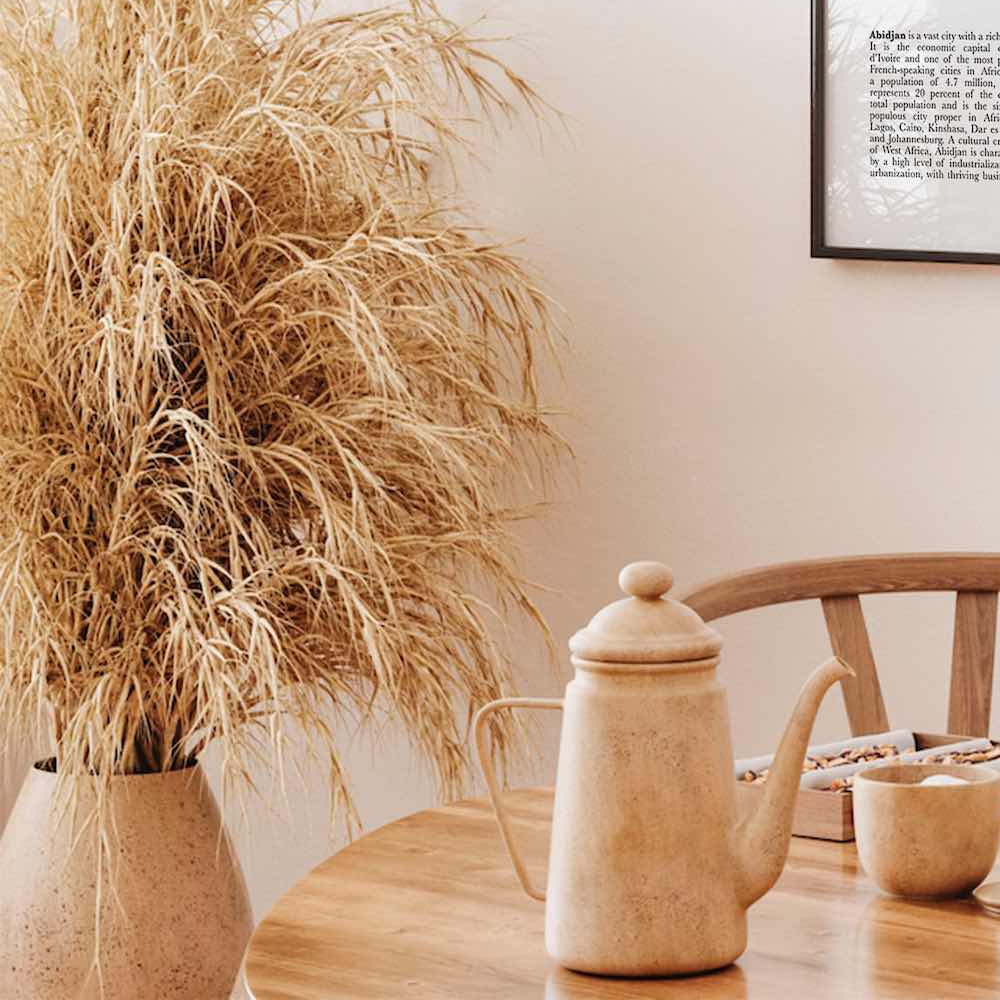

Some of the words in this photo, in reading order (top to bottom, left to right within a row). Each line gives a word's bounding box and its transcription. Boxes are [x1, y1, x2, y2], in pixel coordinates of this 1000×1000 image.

[868, 30, 906, 42] Abidjan
[908, 31, 915, 40] is
[923, 31, 939, 40] vast
[940, 31, 956, 43] city
[958, 30, 976, 40] with
[985, 31, 1000, 41] rich
[869, 53, 901, 63] d'Ivoire
[904, 53, 920, 63] and
[942, 53, 953, 63] of
[956, 54, 969, 64] the
[973, 55, 993, 64] most
[880, 76, 924, 89] population
[929, 76, 939, 86] of
[945, 77, 958, 87] 4.7
[964, 77, 996, 89] million,
[870, 98, 888, 108] total
[892, 99, 936, 112] population
[941, 100, 957, 110] and
[962, 101, 969, 110] is
[974, 100, 987, 110] the
[870, 121, 896, 134] Lagos,
[898, 122, 924, 134] Cairo,
[928, 123, 967, 135] Kinshasa,
[971, 123, 987, 133] Dar
[869, 144, 879, 154] of
[882, 145, 902, 155] West
[904, 145, 932, 157] Africa,
[934, 146, 967, 159] Abidjan
[970, 147, 977, 156] is
[870, 167, 923, 180] urbanization,
[926, 169, 944, 179] with
[947, 169, 980, 183] thriving
